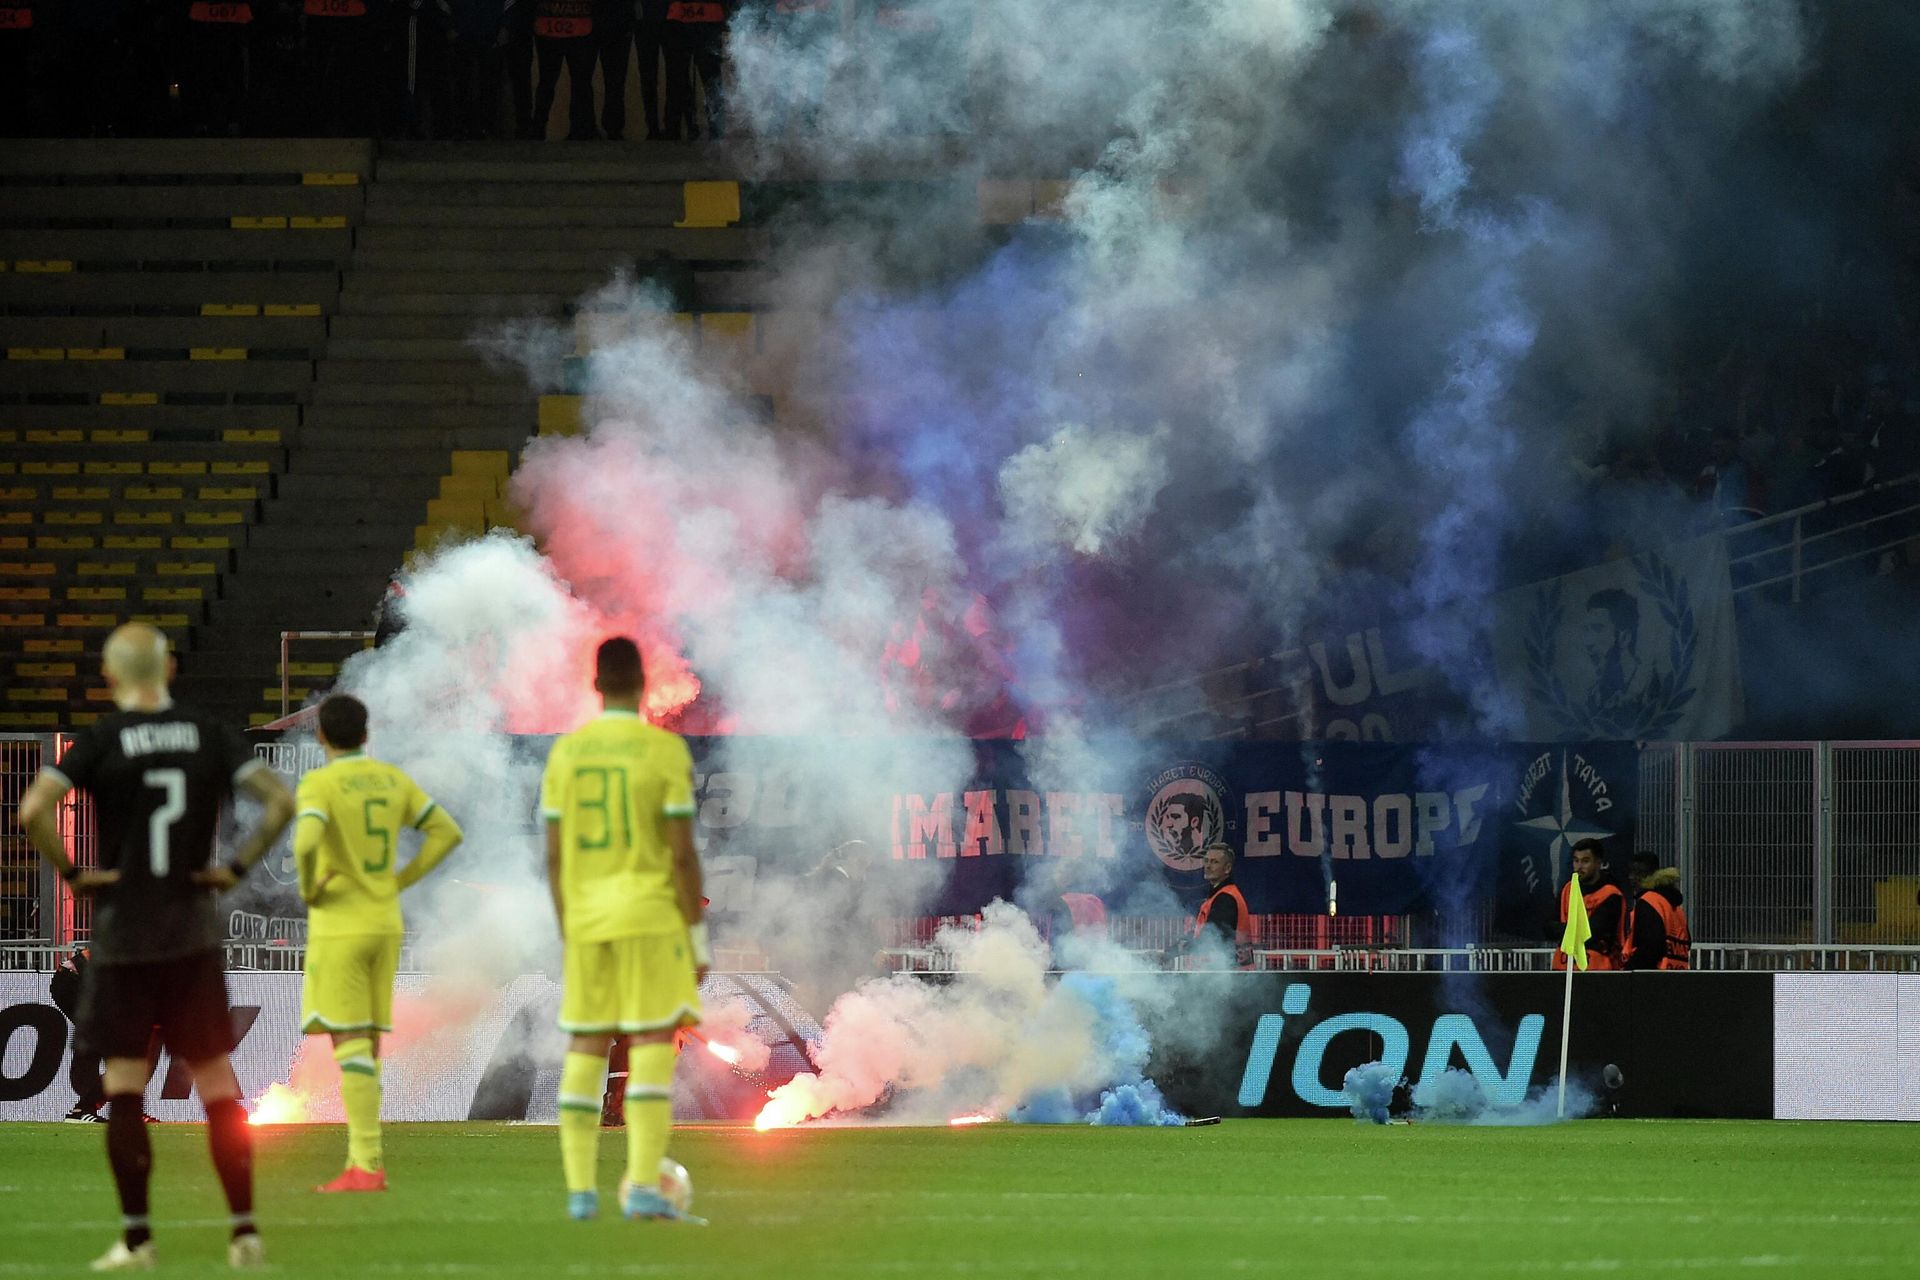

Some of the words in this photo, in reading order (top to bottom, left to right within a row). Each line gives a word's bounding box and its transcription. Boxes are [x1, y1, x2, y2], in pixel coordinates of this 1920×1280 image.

[574, 764, 633, 850] 31
[1573, 753, 1613, 812] TAYFA
[143, 767, 188, 878] 7
[363, 797, 390, 873] 5
[229, 909, 267, 939] OUR
